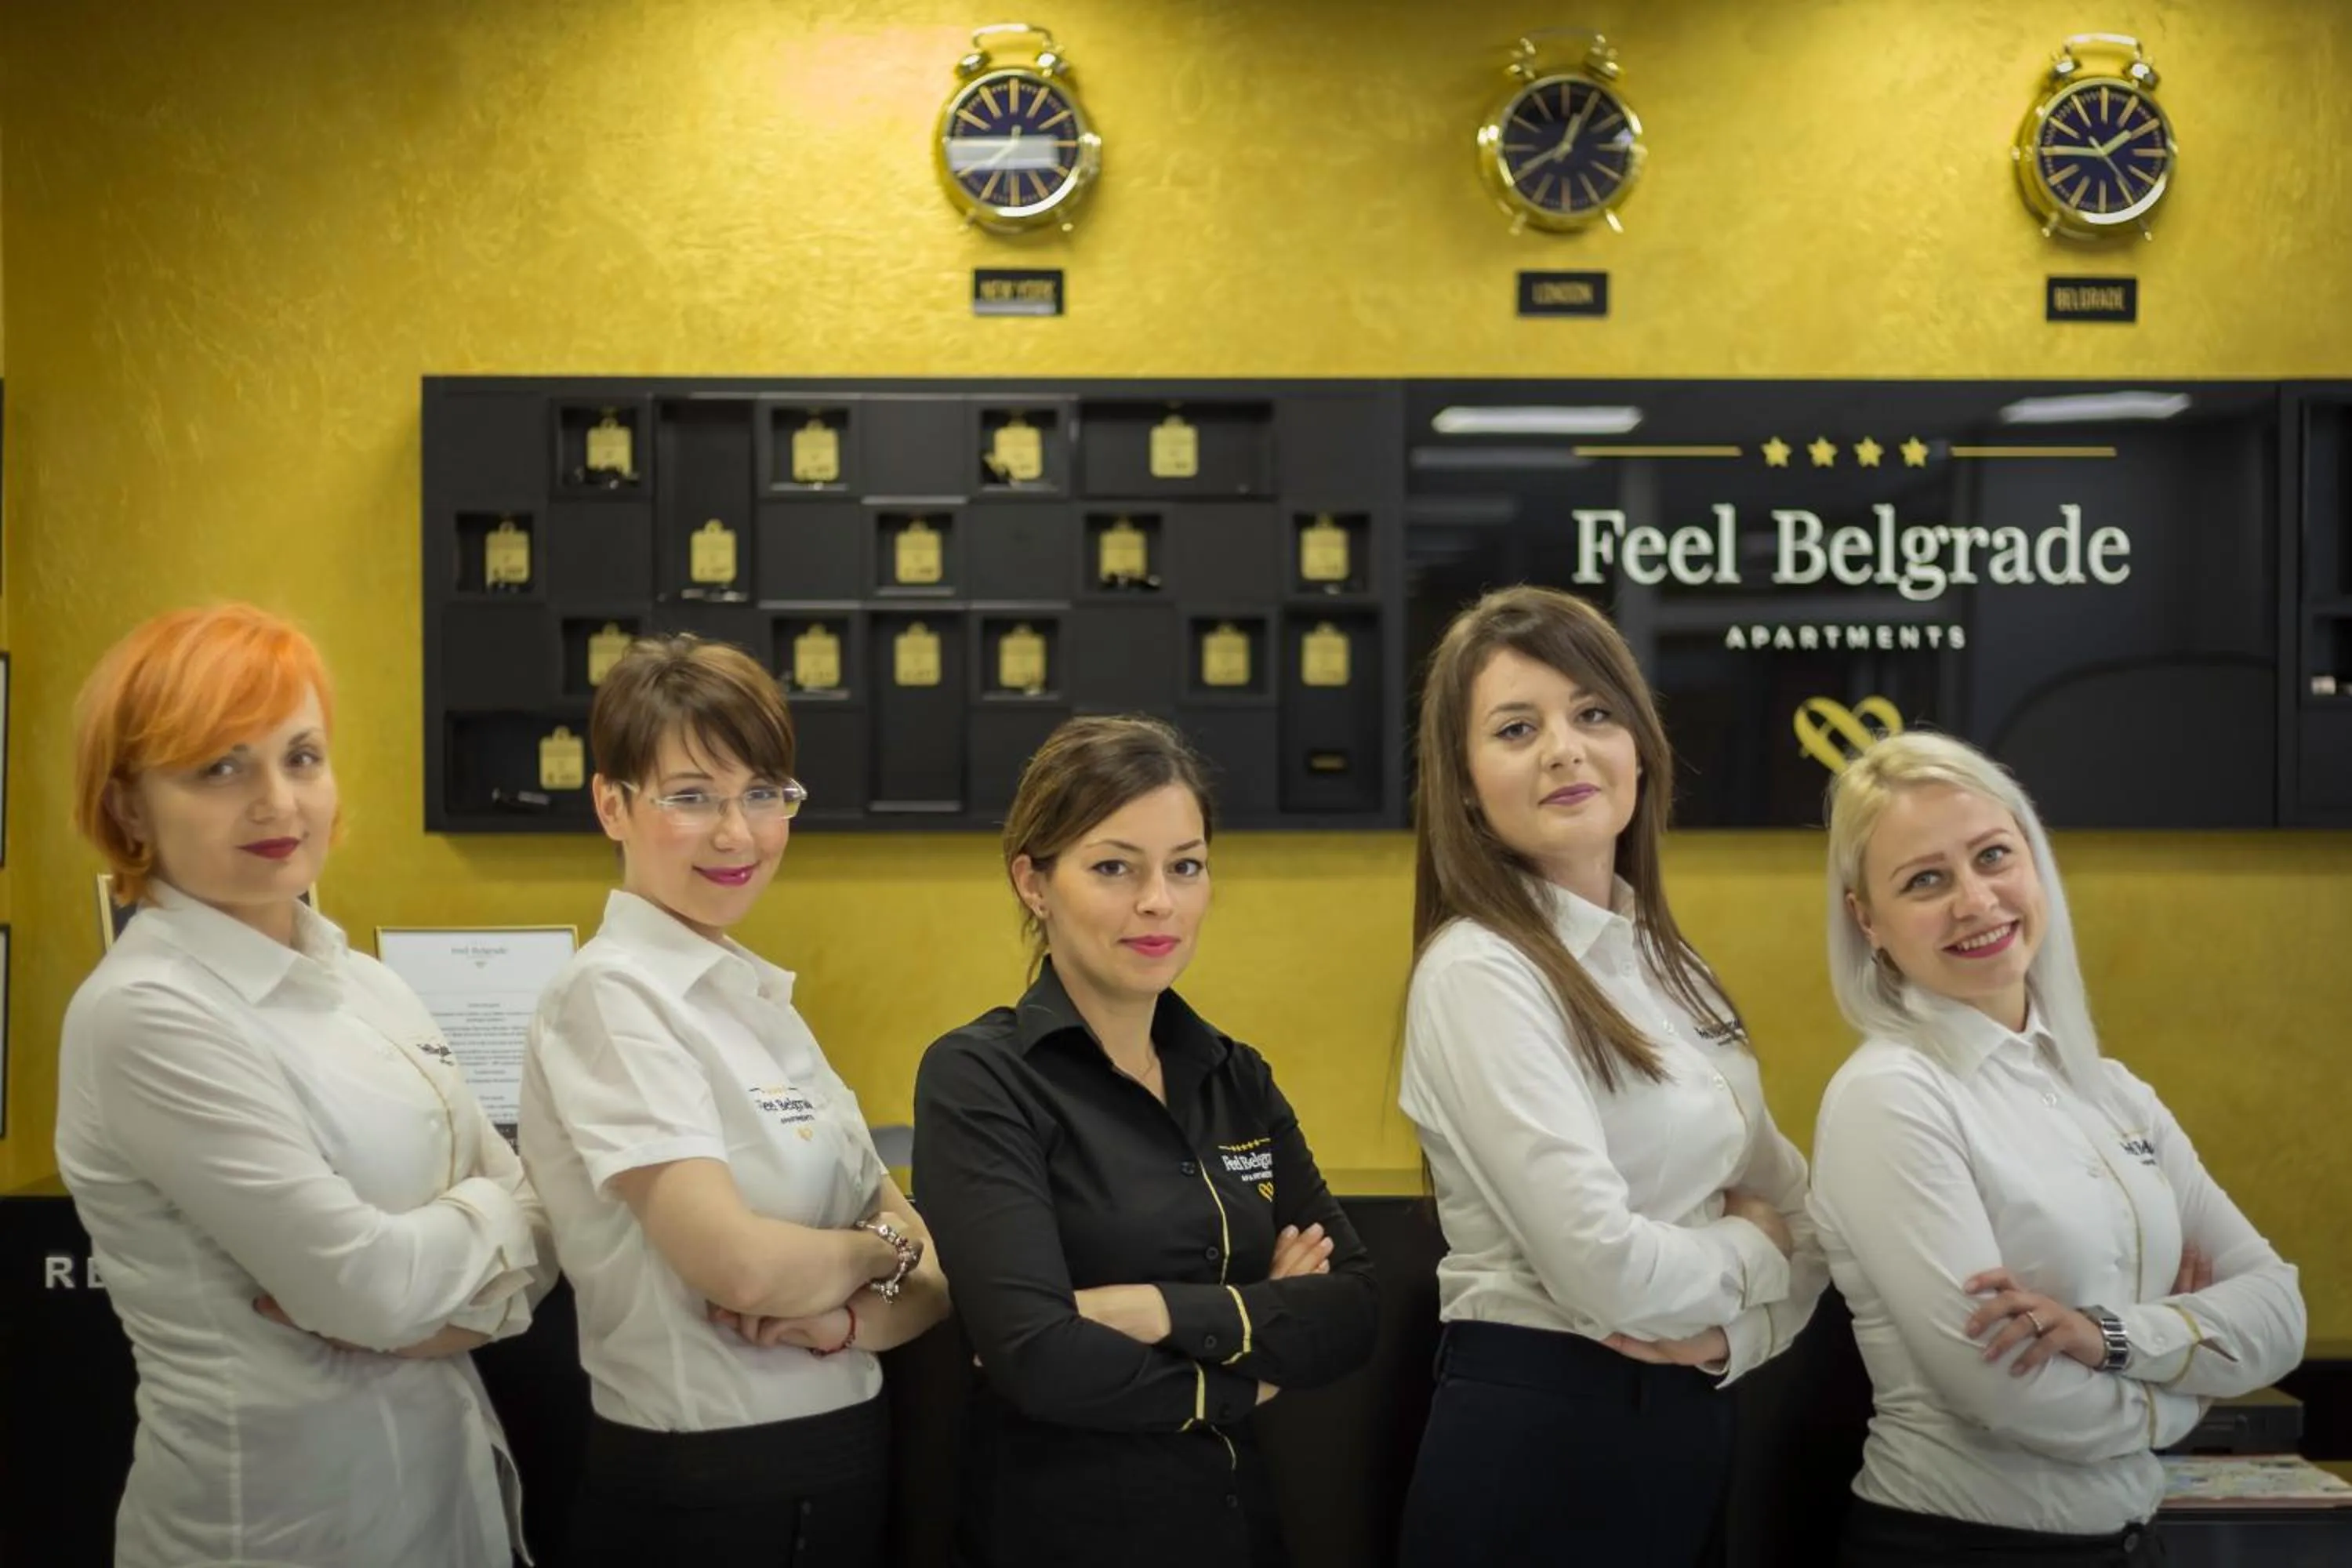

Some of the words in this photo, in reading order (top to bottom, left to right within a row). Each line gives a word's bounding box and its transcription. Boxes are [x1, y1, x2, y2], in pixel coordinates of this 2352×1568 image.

[2053, 286, 2125, 311] BELGRADE
[1571, 503, 1742, 586] Feel
[1771, 503, 2132, 601] Belgrade
[1726, 626, 1966, 650] APARTMENTS
